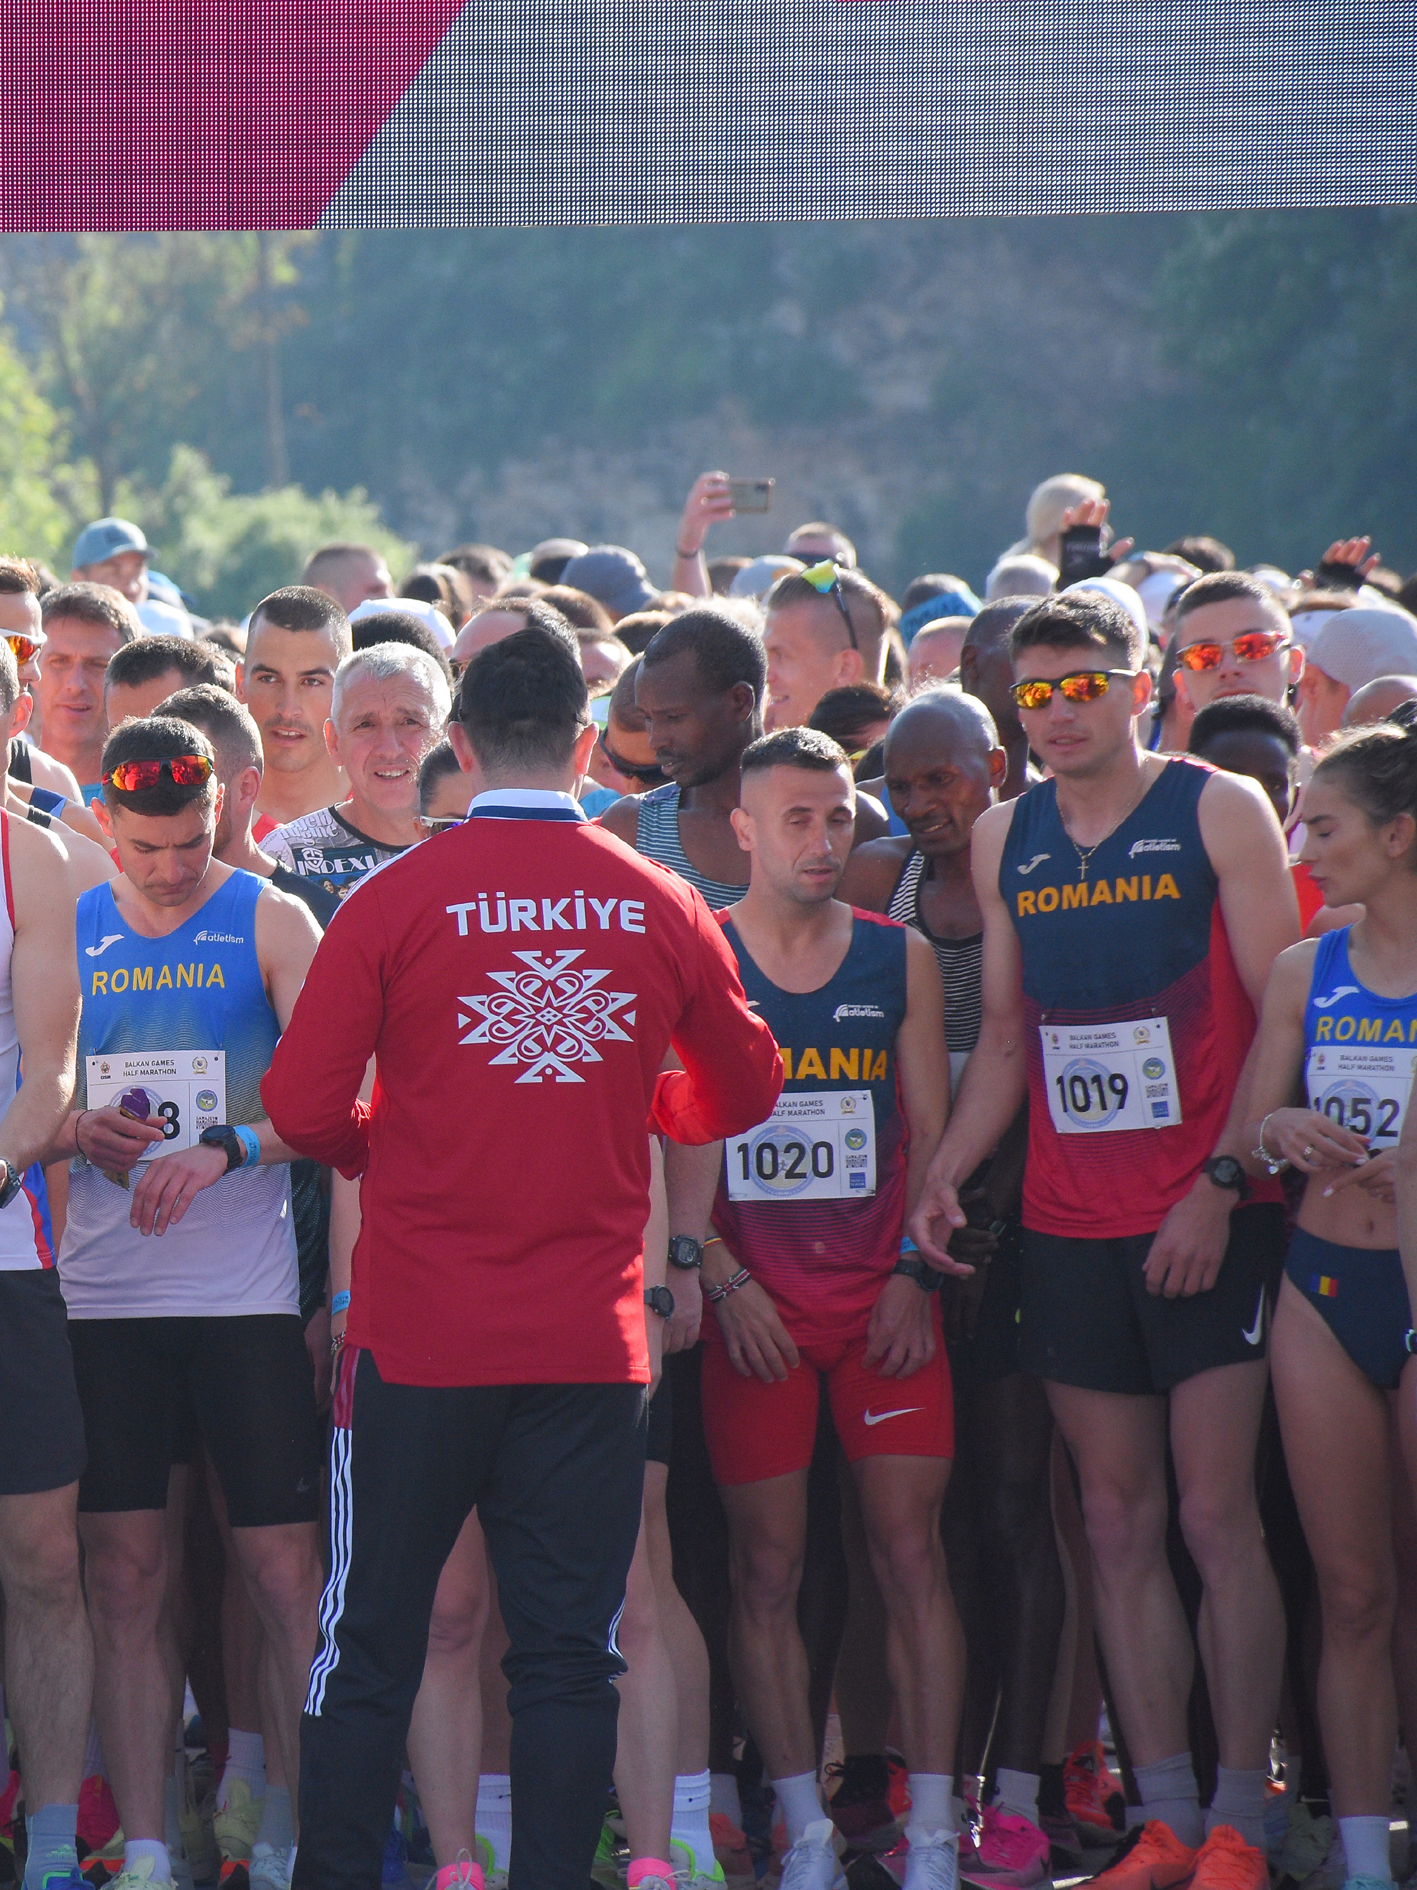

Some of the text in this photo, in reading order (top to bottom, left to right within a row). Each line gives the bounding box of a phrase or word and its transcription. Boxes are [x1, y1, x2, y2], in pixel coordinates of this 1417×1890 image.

[1017, 873, 1181, 917] ROMANIA
[445, 889, 646, 936] TÜRKİYE
[207, 933, 244, 944] atletism
[91, 963, 225, 996] ROMANIA
[123, 1068, 177, 1077] HALF MARATHON
[124, 1059, 175, 1068] BALKAN GAMES
[774, 1099, 823, 1108] ALKAN GAMES
[1055, 1073, 1129, 1113] 1019
[787, 1108, 826, 1116] MARATHON
[736, 1141, 834, 1181] 1020
